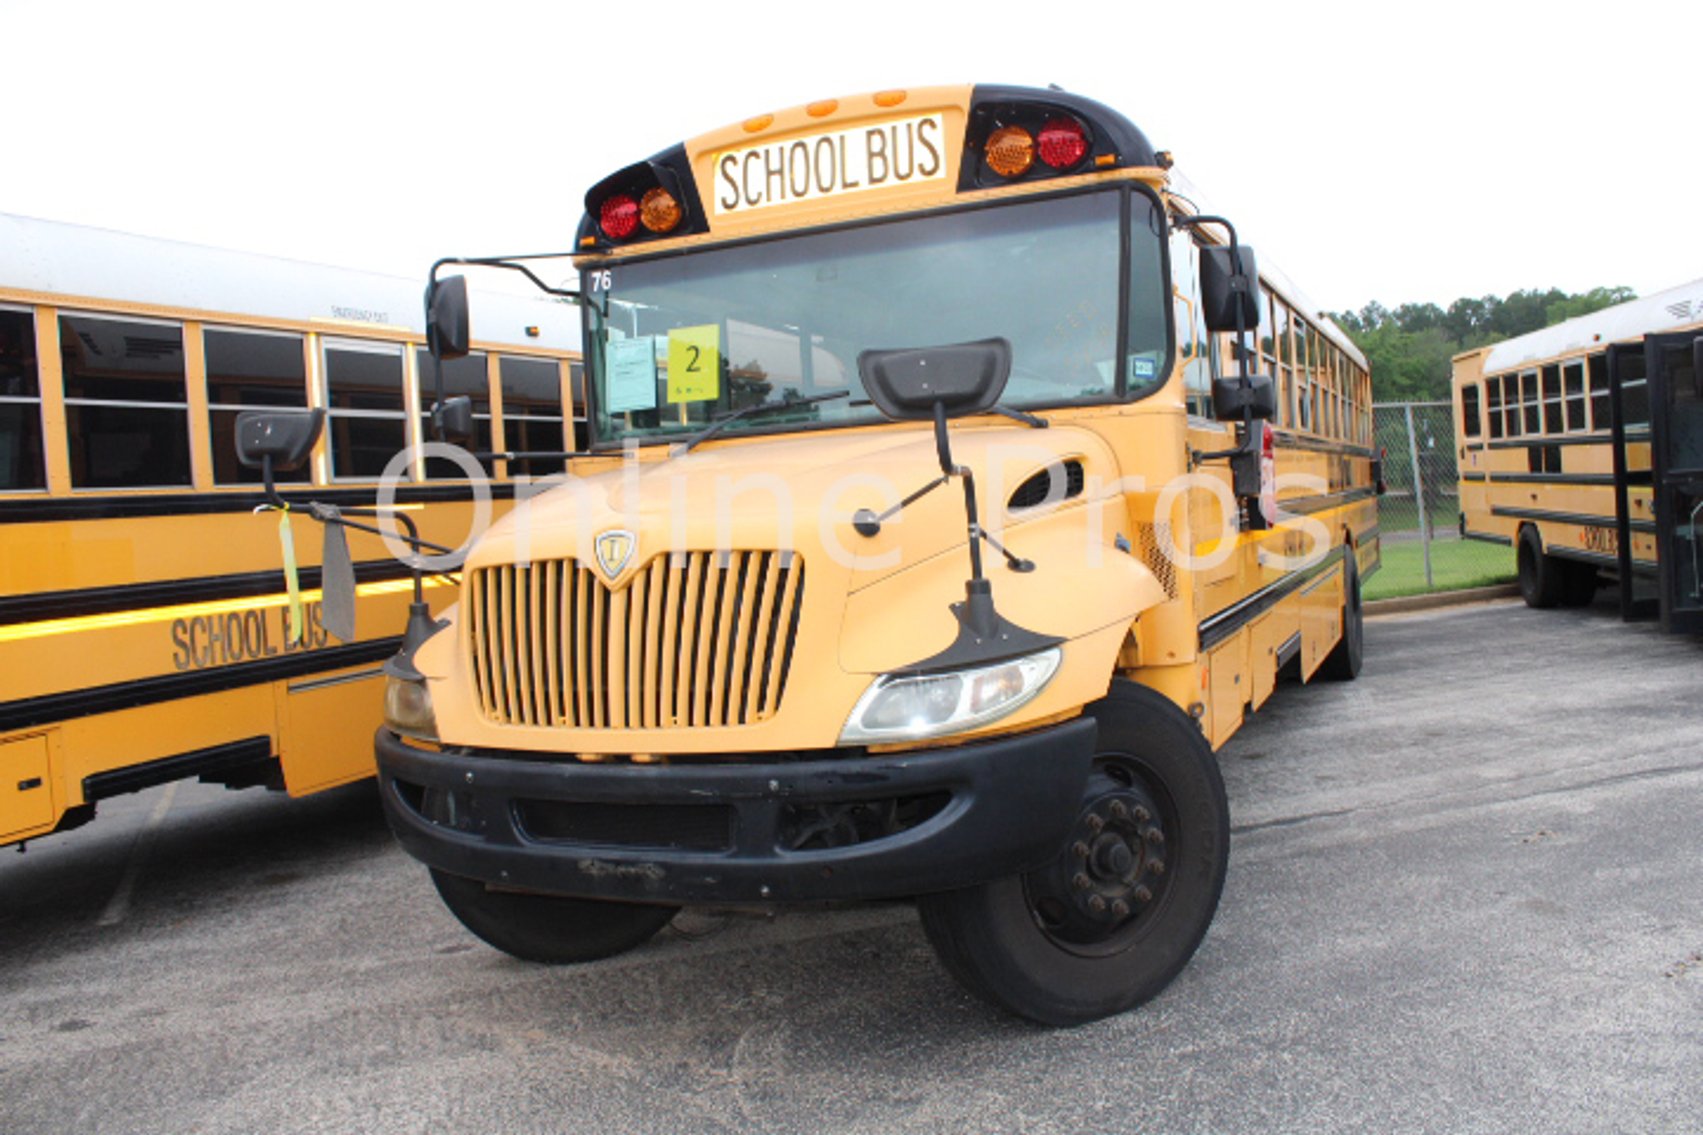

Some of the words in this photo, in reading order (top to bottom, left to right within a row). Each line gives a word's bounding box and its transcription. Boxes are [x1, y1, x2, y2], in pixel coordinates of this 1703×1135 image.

[720, 134, 859, 210] SCHOOL
[866, 117, 941, 185] BUS
[592, 270, 612, 292] 76
[685, 345, 702, 373] 2
[172, 608, 278, 671] SCHOOL
